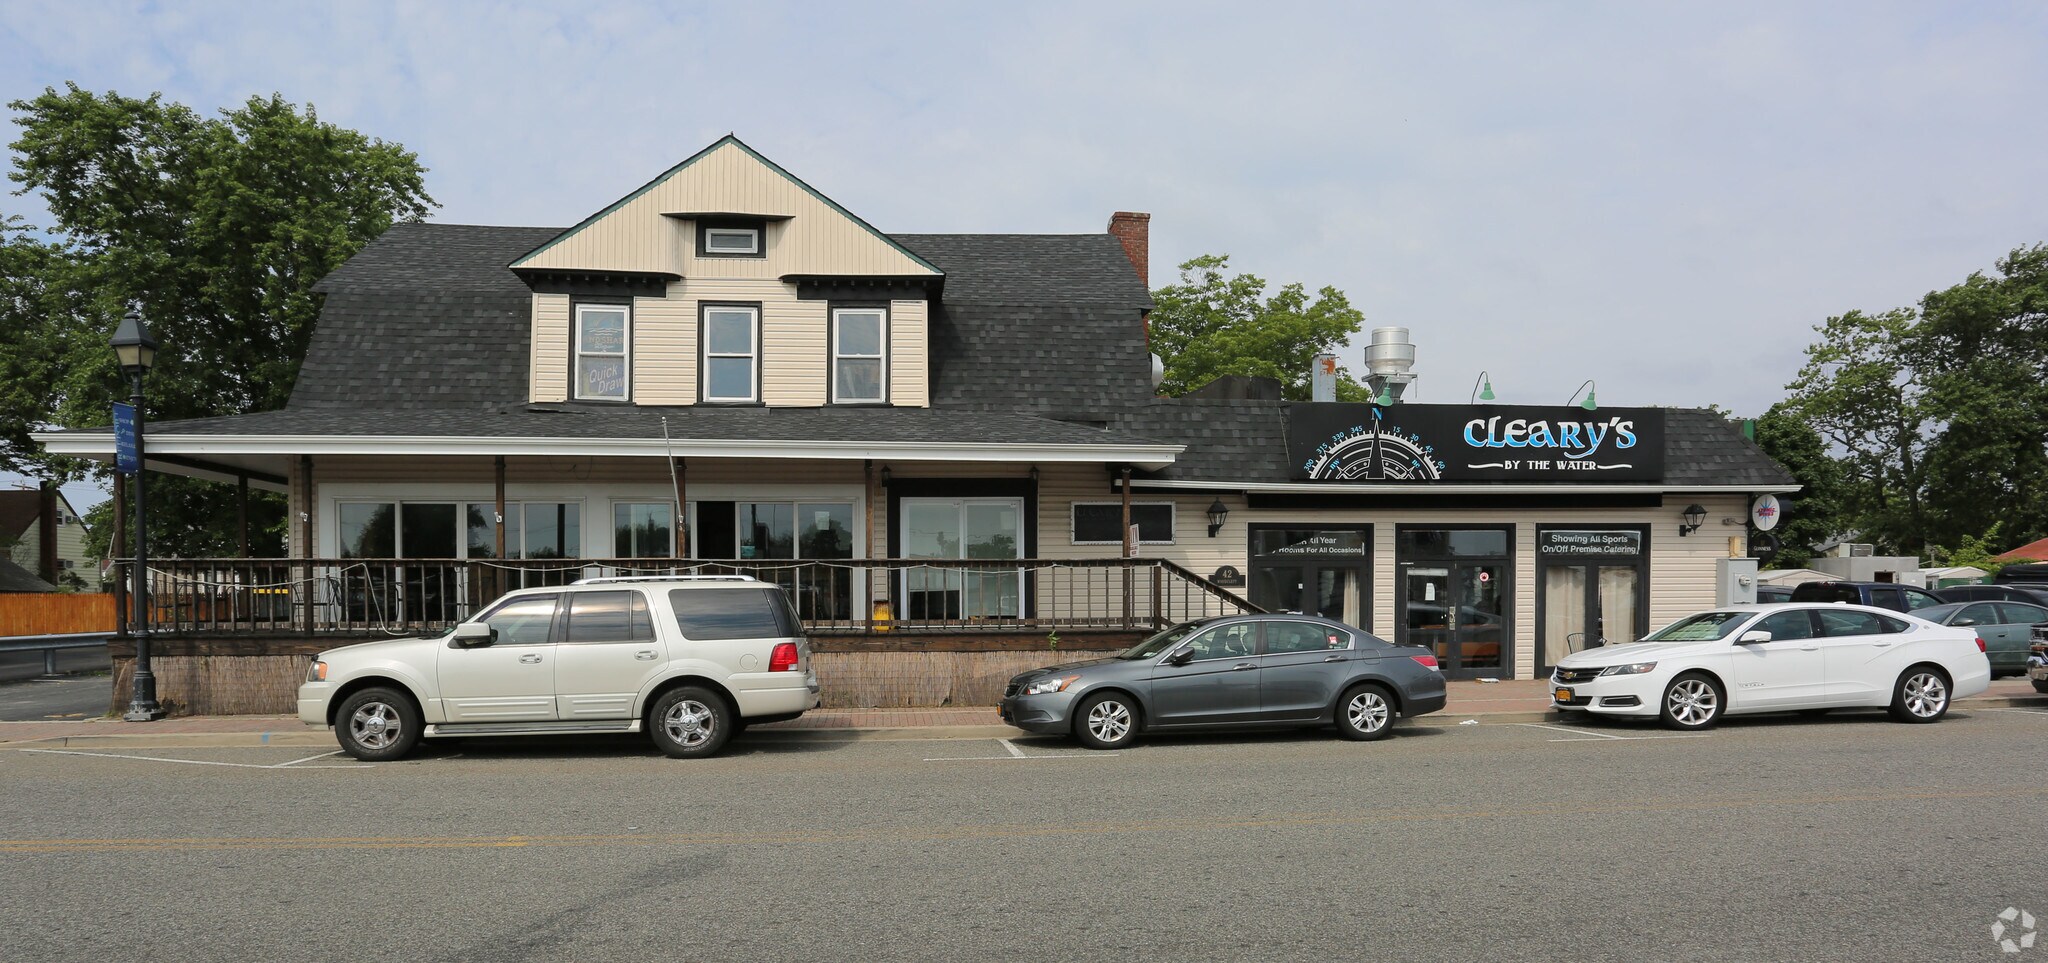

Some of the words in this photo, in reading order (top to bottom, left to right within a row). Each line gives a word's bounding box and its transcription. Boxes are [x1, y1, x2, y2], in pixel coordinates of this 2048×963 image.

[590, 364, 618, 384] Quick
[1371, 407, 1383, 421] N
[1303, 459, 1314, 472] 300
[1316, 442, 1328, 455] 315
[1332, 431, 1345, 442] 330
[1350, 425, 1363, 434] 345
[1392, 426, 1401, 434] 15
[1411, 433, 1420, 442] 30
[1425, 444, 1434, 454] 45
[1438, 460, 1446, 470] 60
[1504, 460, 1520, 470] BY
[1527, 460, 1550, 470] THE
[1556, 460, 1596, 470] WATER
[1320, 536, 1337, 544] Year
[1551, 534, 1588, 545] Showing
[1590, 535, 1601, 543] All
[1602, 535, 1628, 544] Sports
[1542, 545, 1569, 553] On/Off
[1570, 545, 1602, 553] Premise
[1604, 545, 1636, 555] Catering
[1222, 570, 1233, 578] 42
